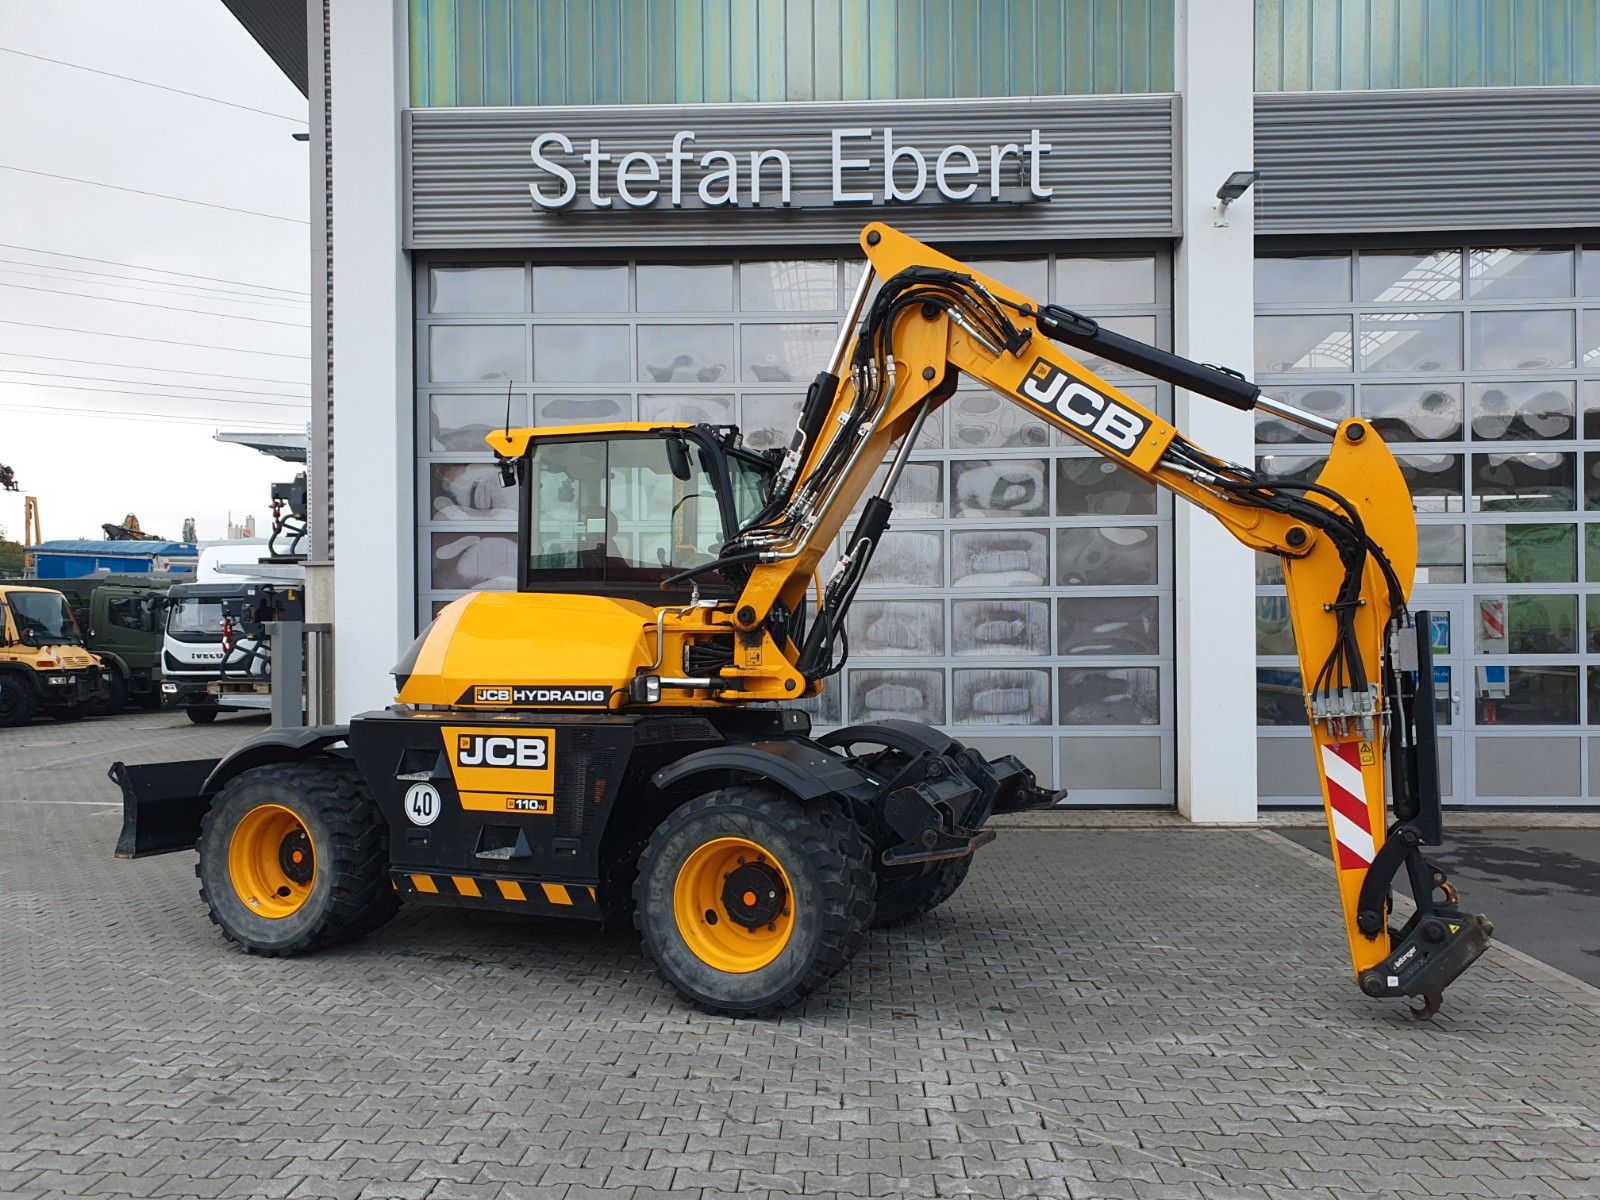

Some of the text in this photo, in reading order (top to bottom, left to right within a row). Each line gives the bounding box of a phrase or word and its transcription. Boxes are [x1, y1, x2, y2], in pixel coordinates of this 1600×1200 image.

[528, 126, 1054, 210] Stefan Ebert
[1022, 370, 1145, 452] JCB
[477, 690, 604, 701] JCB HYDRADIG
[460, 737, 546, 767] JCB
[412, 790, 432, 817] 40
